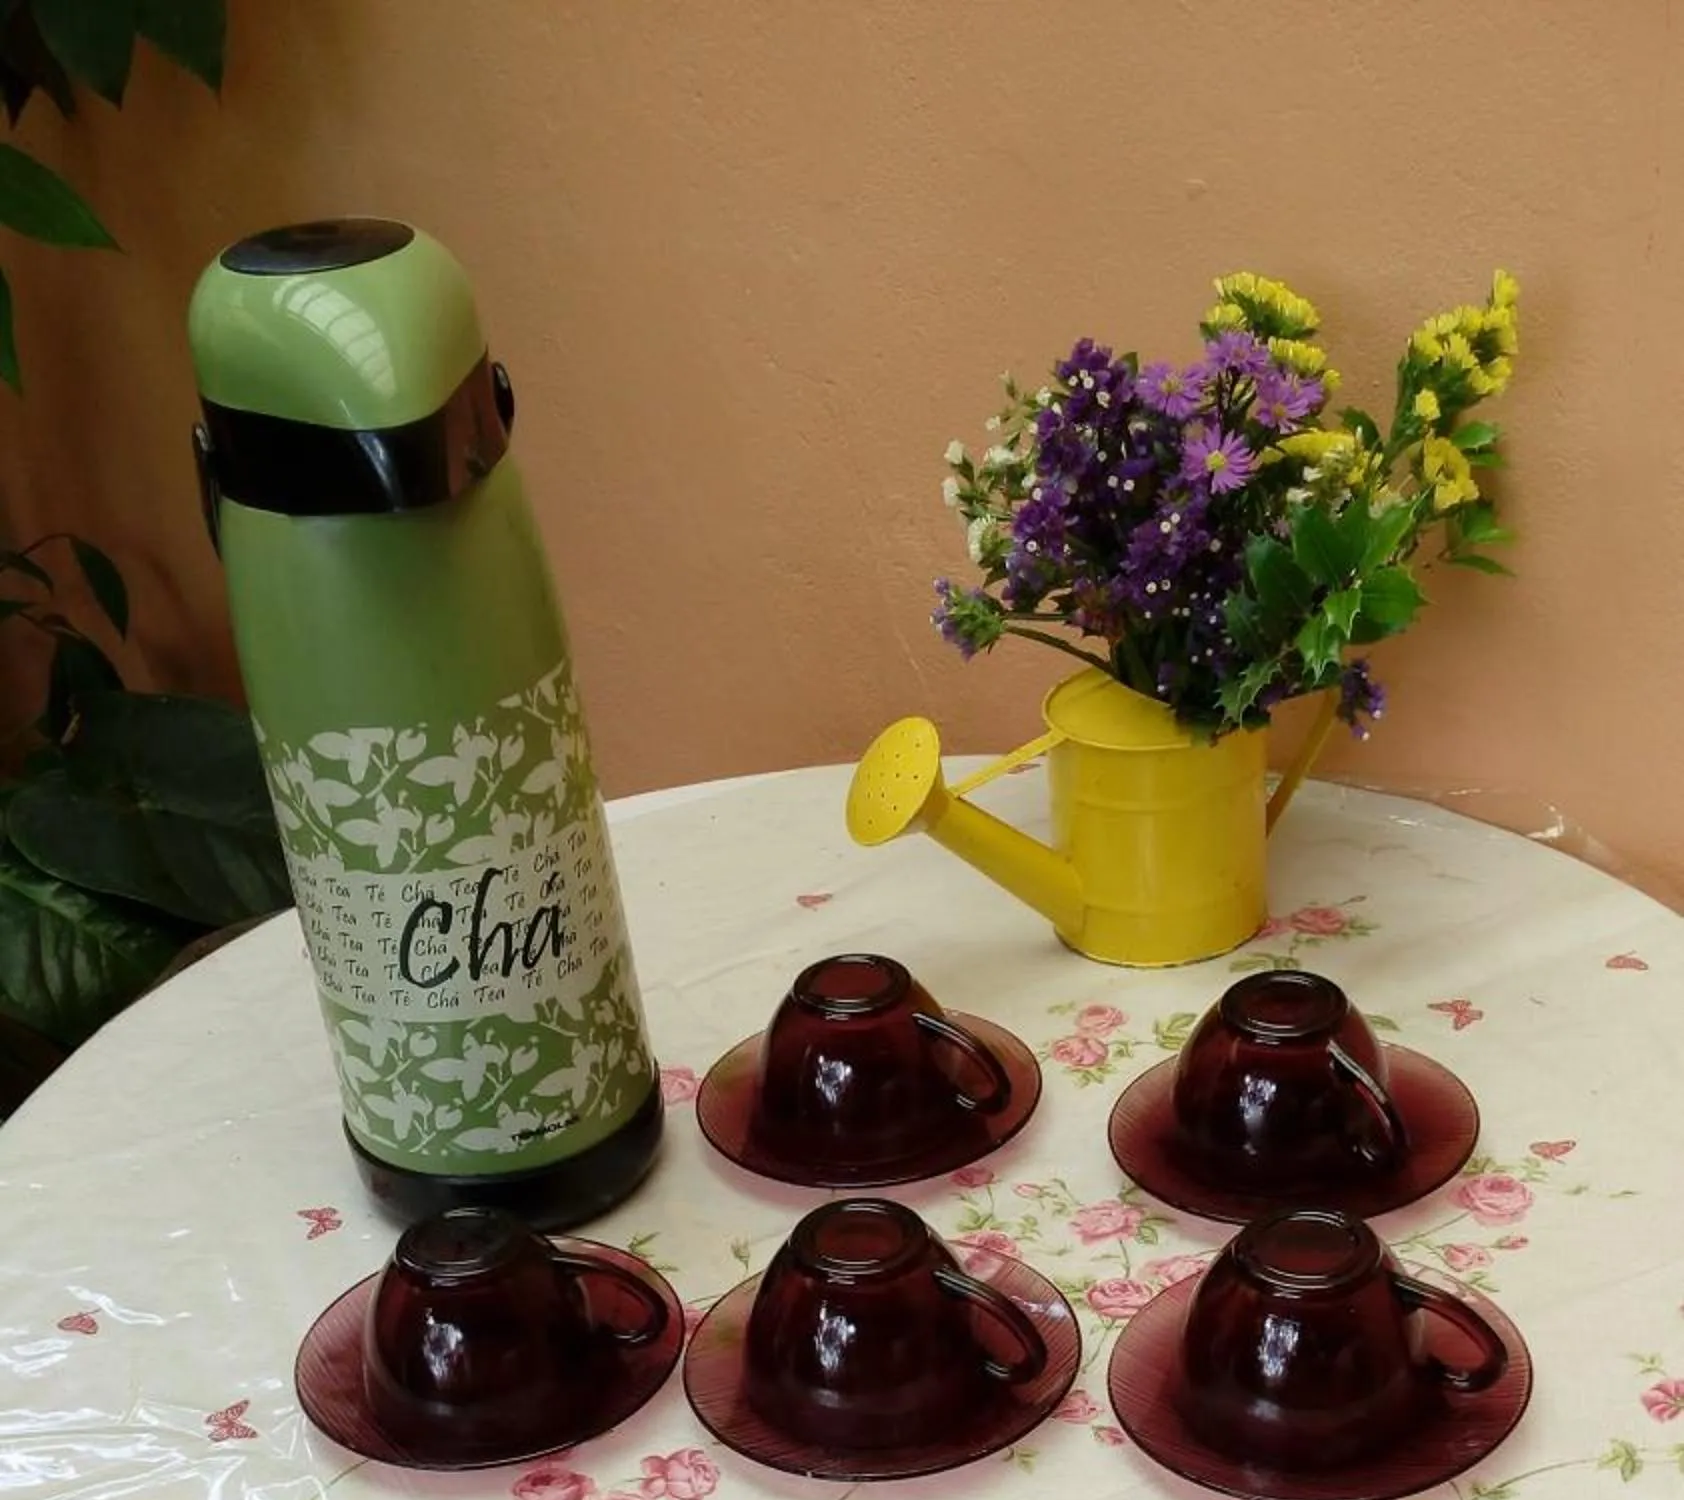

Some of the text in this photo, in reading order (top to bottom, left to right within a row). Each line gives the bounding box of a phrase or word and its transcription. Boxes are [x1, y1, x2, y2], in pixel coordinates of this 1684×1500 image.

[325, 877, 350, 898] Tea
[401, 880, 435, 902] Chá
[332, 905, 357, 925] Tea
[338, 932, 363, 953] Tea
[414, 935, 447, 956] Chá
[345, 960, 369, 978] Tea
[351, 985, 375, 1003] Tea
[427, 987, 459, 1008] Chá
[473, 985, 505, 1004] Tea
